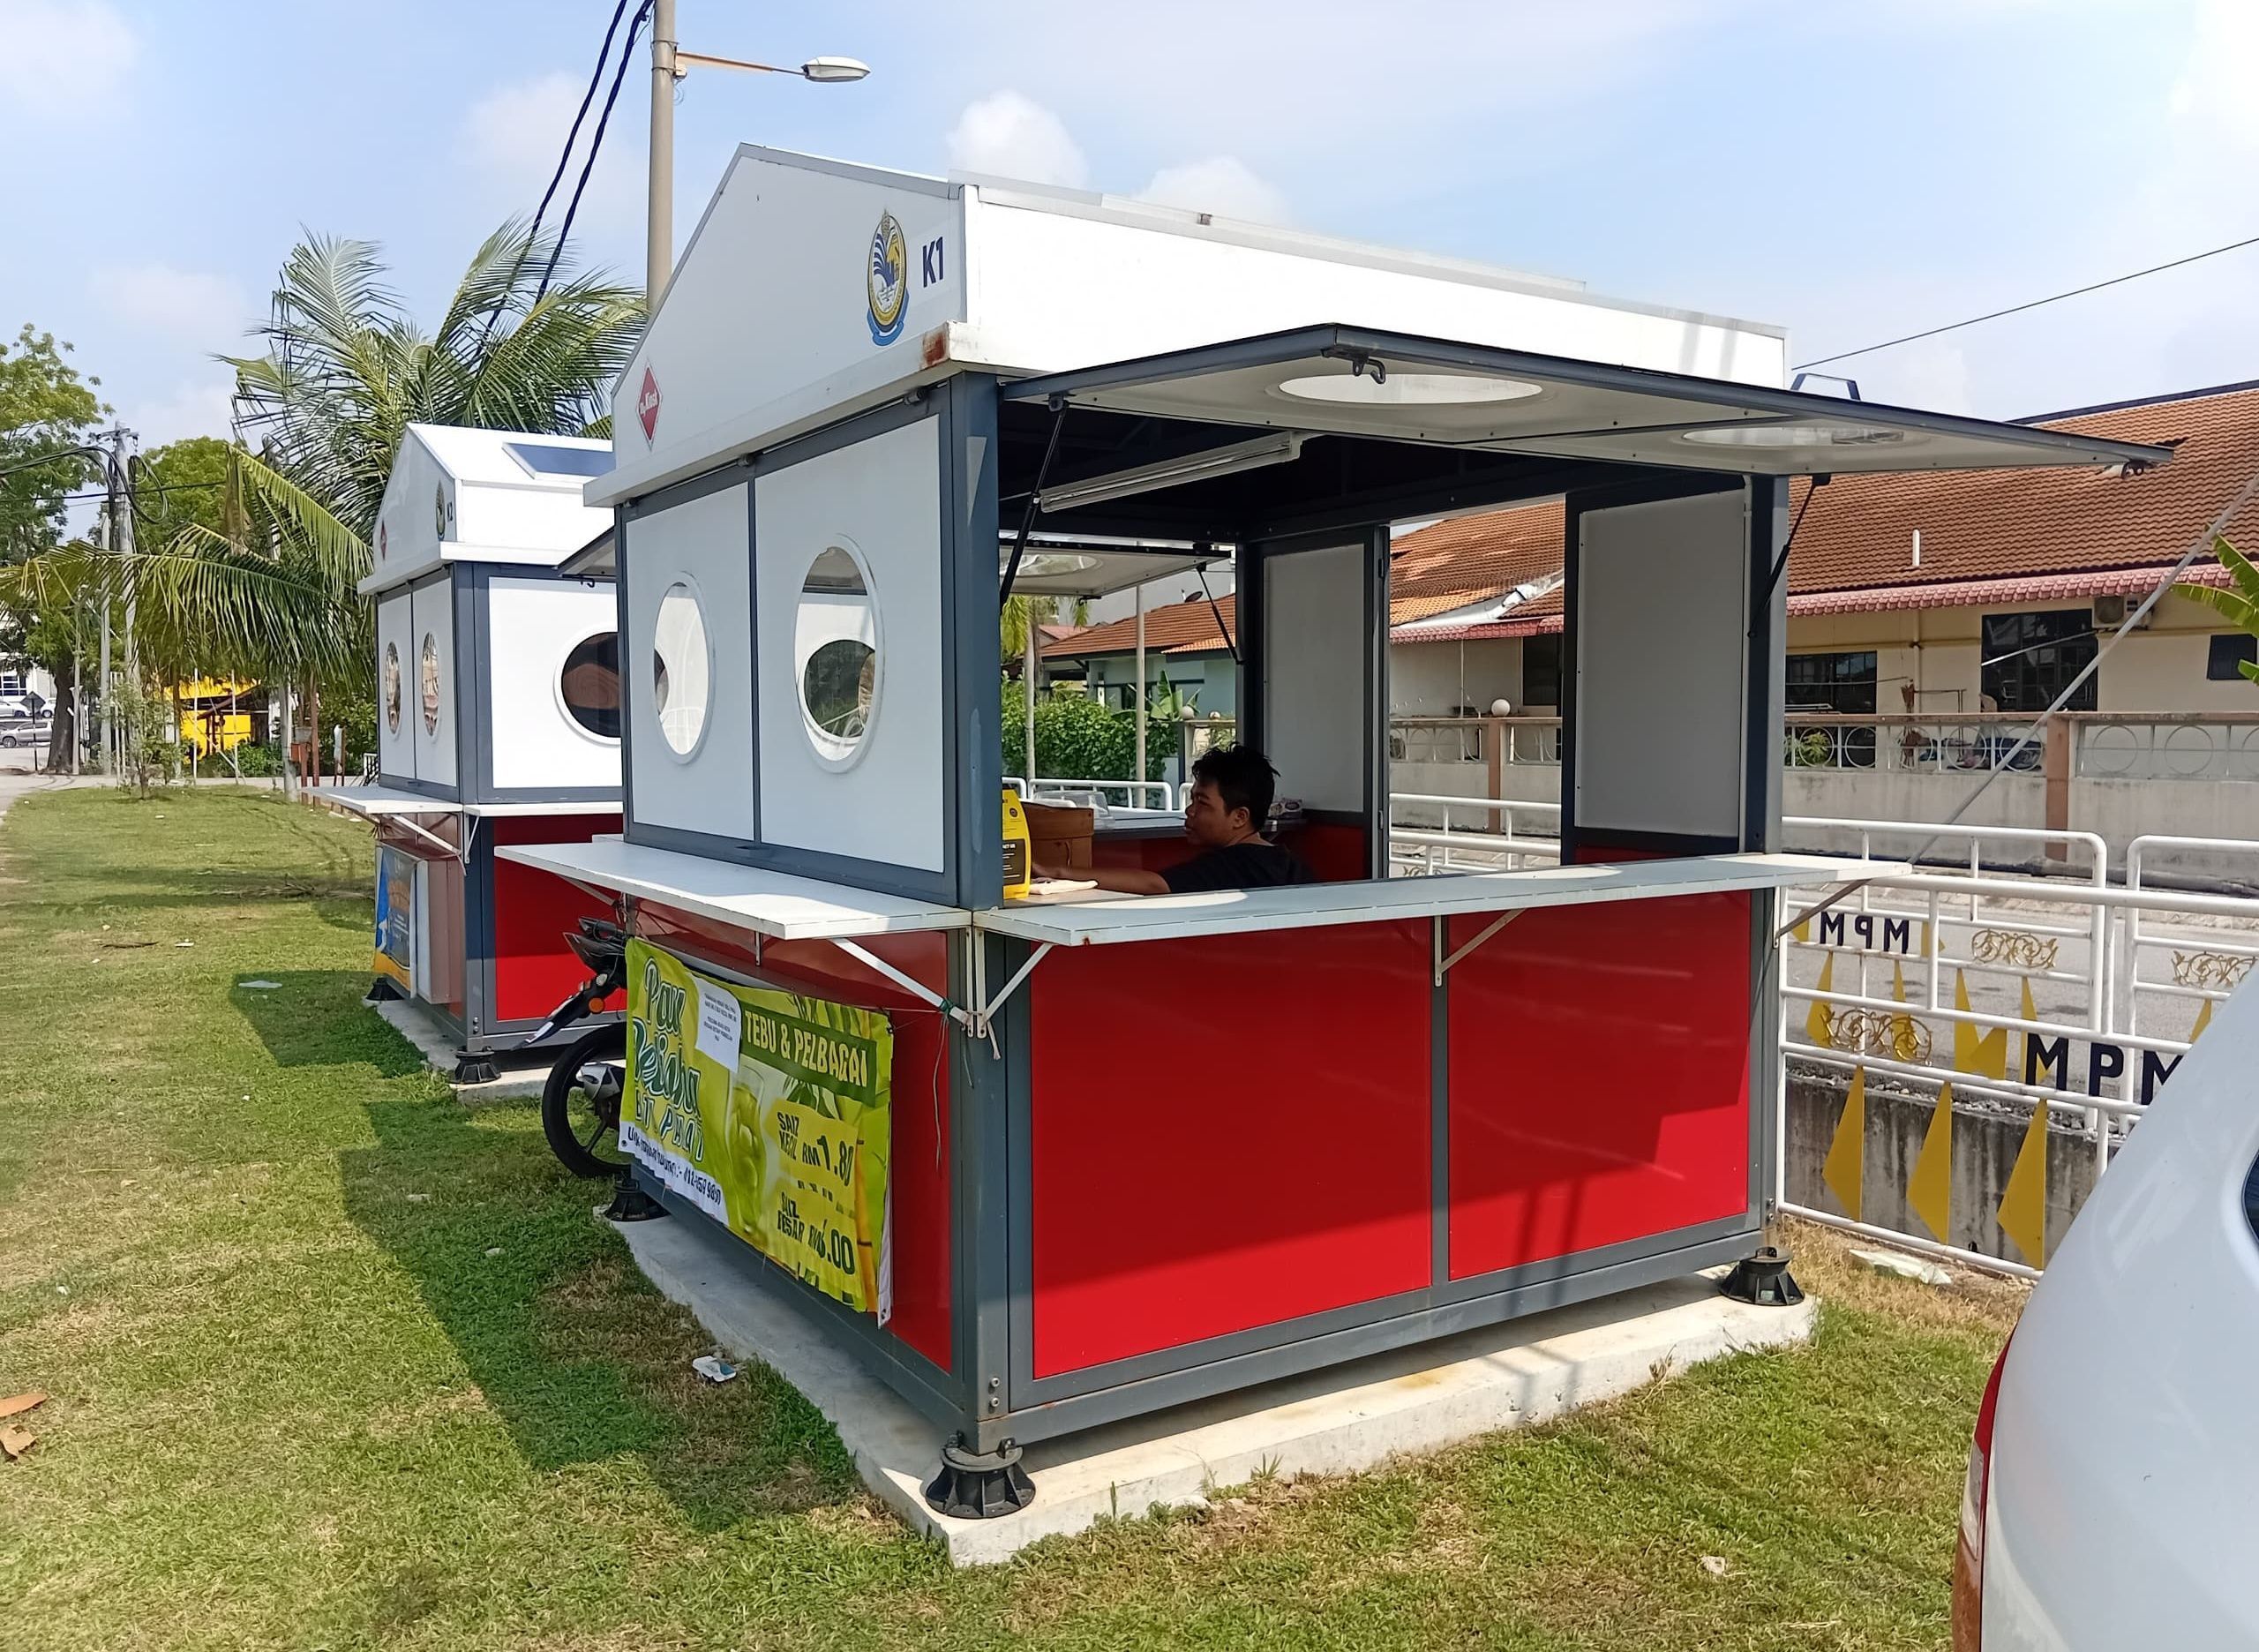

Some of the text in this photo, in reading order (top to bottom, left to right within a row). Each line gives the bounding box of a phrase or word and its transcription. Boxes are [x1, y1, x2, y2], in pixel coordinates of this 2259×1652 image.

[745, 1010, 777, 1053] TEBU
[780, 1023, 791, 1060] &
[794, 1028, 867, 1087] PELBAGAI
[777, 1111, 799, 1137] SAIZ
[922, 1118, 943, 1170] K1
